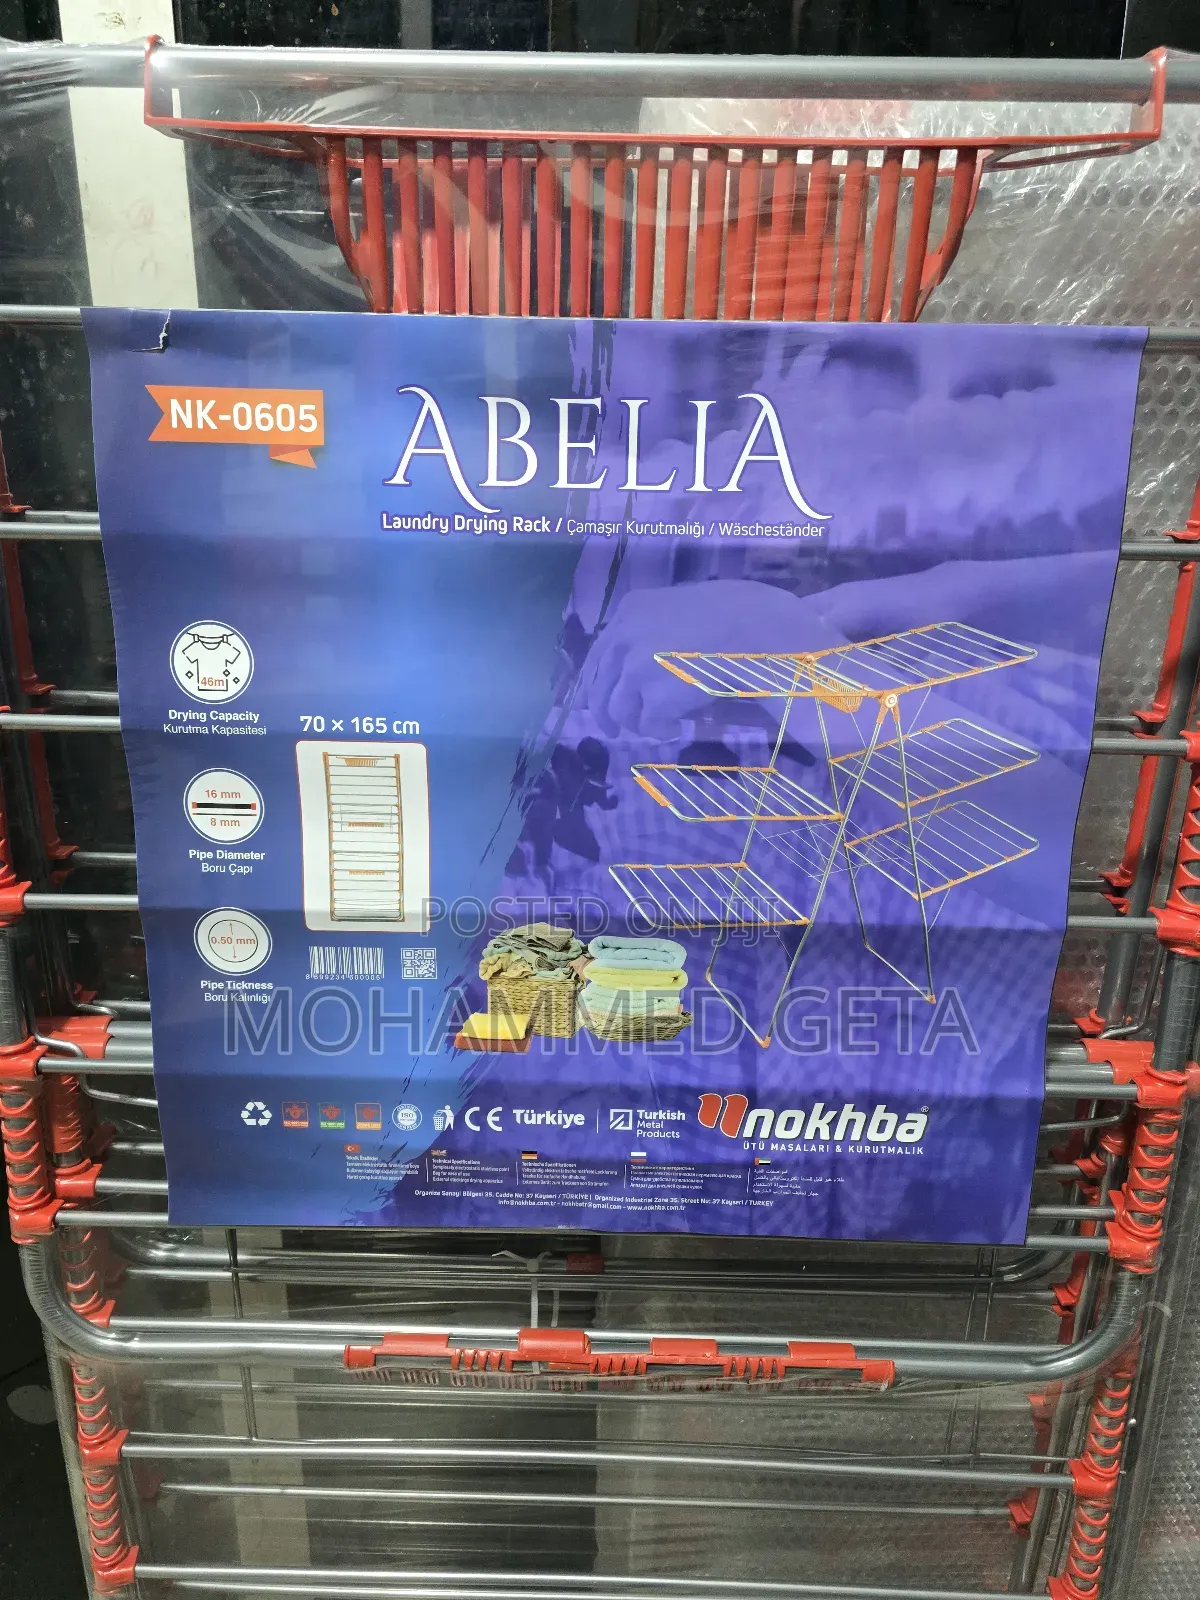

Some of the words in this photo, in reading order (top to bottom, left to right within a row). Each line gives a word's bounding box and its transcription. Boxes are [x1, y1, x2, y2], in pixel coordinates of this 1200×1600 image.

[169, 397, 318, 434] NK-0605
[385, 386, 832, 520] ABELIA
[382, 512, 449, 533] Laundry
[454, 514, 508, 535] Drying
[513, 515, 551, 533] Rack
[567, 519, 622, 538] Çamaşır
[626, 519, 705, 538] Kurutmalığı
[719, 520, 825, 538] Wäscheständer
[200, 677, 225, 687] 46m
[168, 709, 207, 722] Drying
[209, 710, 260, 723] Capacity
[163, 723, 209, 734] Kurutma
[211, 724, 267, 736] Kapasitesi
[300, 716, 325, 732] 70
[351, 717, 388, 734] 165
[392, 719, 420, 734] cm
[205, 789, 217, 799] 16
[220, 791, 241, 799] mm
[210, 817, 217, 827] 8
[219, 819, 241, 827] mm
[189, 850, 213, 861] Pipe
[216, 850, 265, 860] Diameter
[201, 863, 226, 873] Boru
[228, 863, 253, 876] Çapı
[211, 936, 233, 945] 0.50
[200, 980, 224, 991] Pipe
[226, 980, 273, 990] Tickness
[204, 993, 228, 1002] Boru
[513, 1108, 585, 1129] Türkiye
[636, 1109, 686, 1121] Turkish
[636, 1119, 664, 1129] Metal
[636, 1129, 680, 1139] Products
[743, 1140, 766, 1151] ÜTÜ
[770, 1143, 830, 1153] MASALARI
[835, 1144, 842, 1153] &
[848, 1145, 924, 1155] KURUTMALIK
